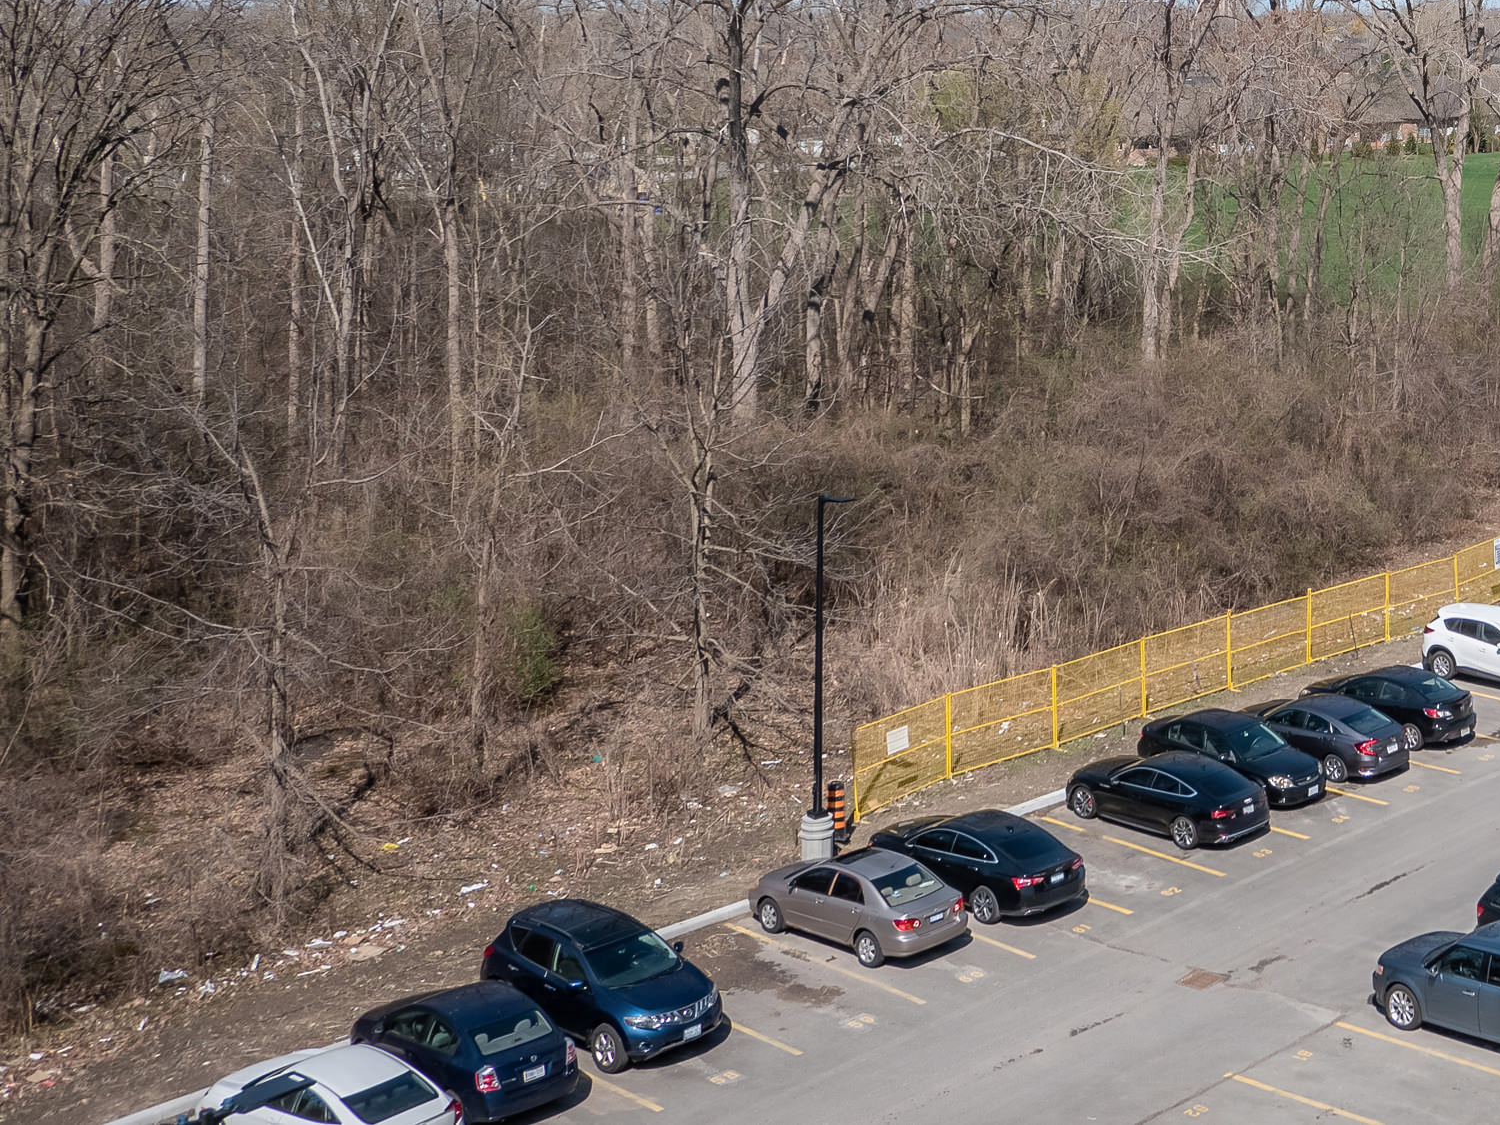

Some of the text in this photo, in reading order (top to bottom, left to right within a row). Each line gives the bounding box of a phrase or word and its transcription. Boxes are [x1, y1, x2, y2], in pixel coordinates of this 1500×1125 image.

[1252, 848, 1273, 858] 63
[1160, 886, 1183, 897] 62
[1072, 924, 1092, 934] 61
[958, 970, 985, 983] 60
